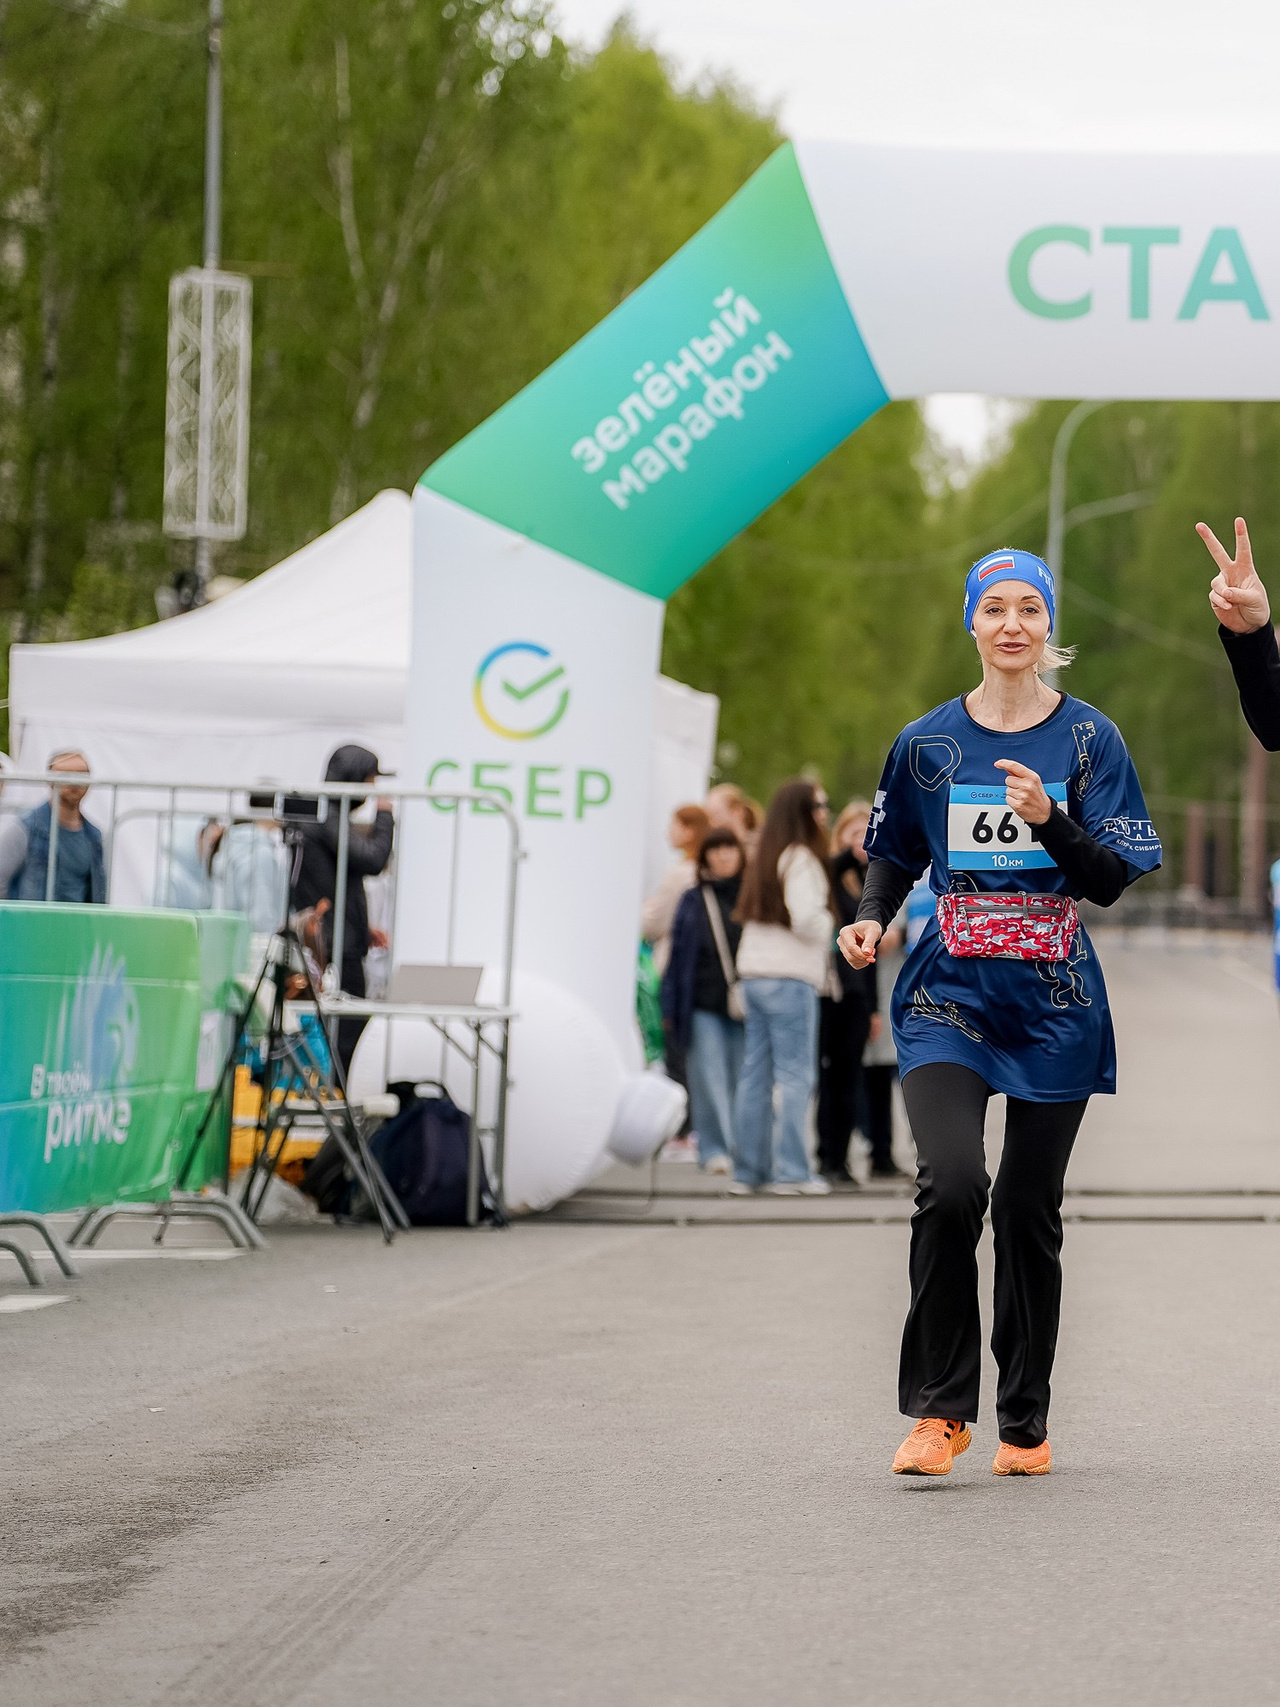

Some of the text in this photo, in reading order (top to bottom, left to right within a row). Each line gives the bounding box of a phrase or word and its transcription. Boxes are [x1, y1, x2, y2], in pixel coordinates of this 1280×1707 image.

[570, 286, 762, 474] зелёный
[602, 330, 793, 511] марафон
[427, 760, 612, 820] СБЕР
[30, 1063, 45, 1099] В
[44, 1099, 131, 1164] ритме
